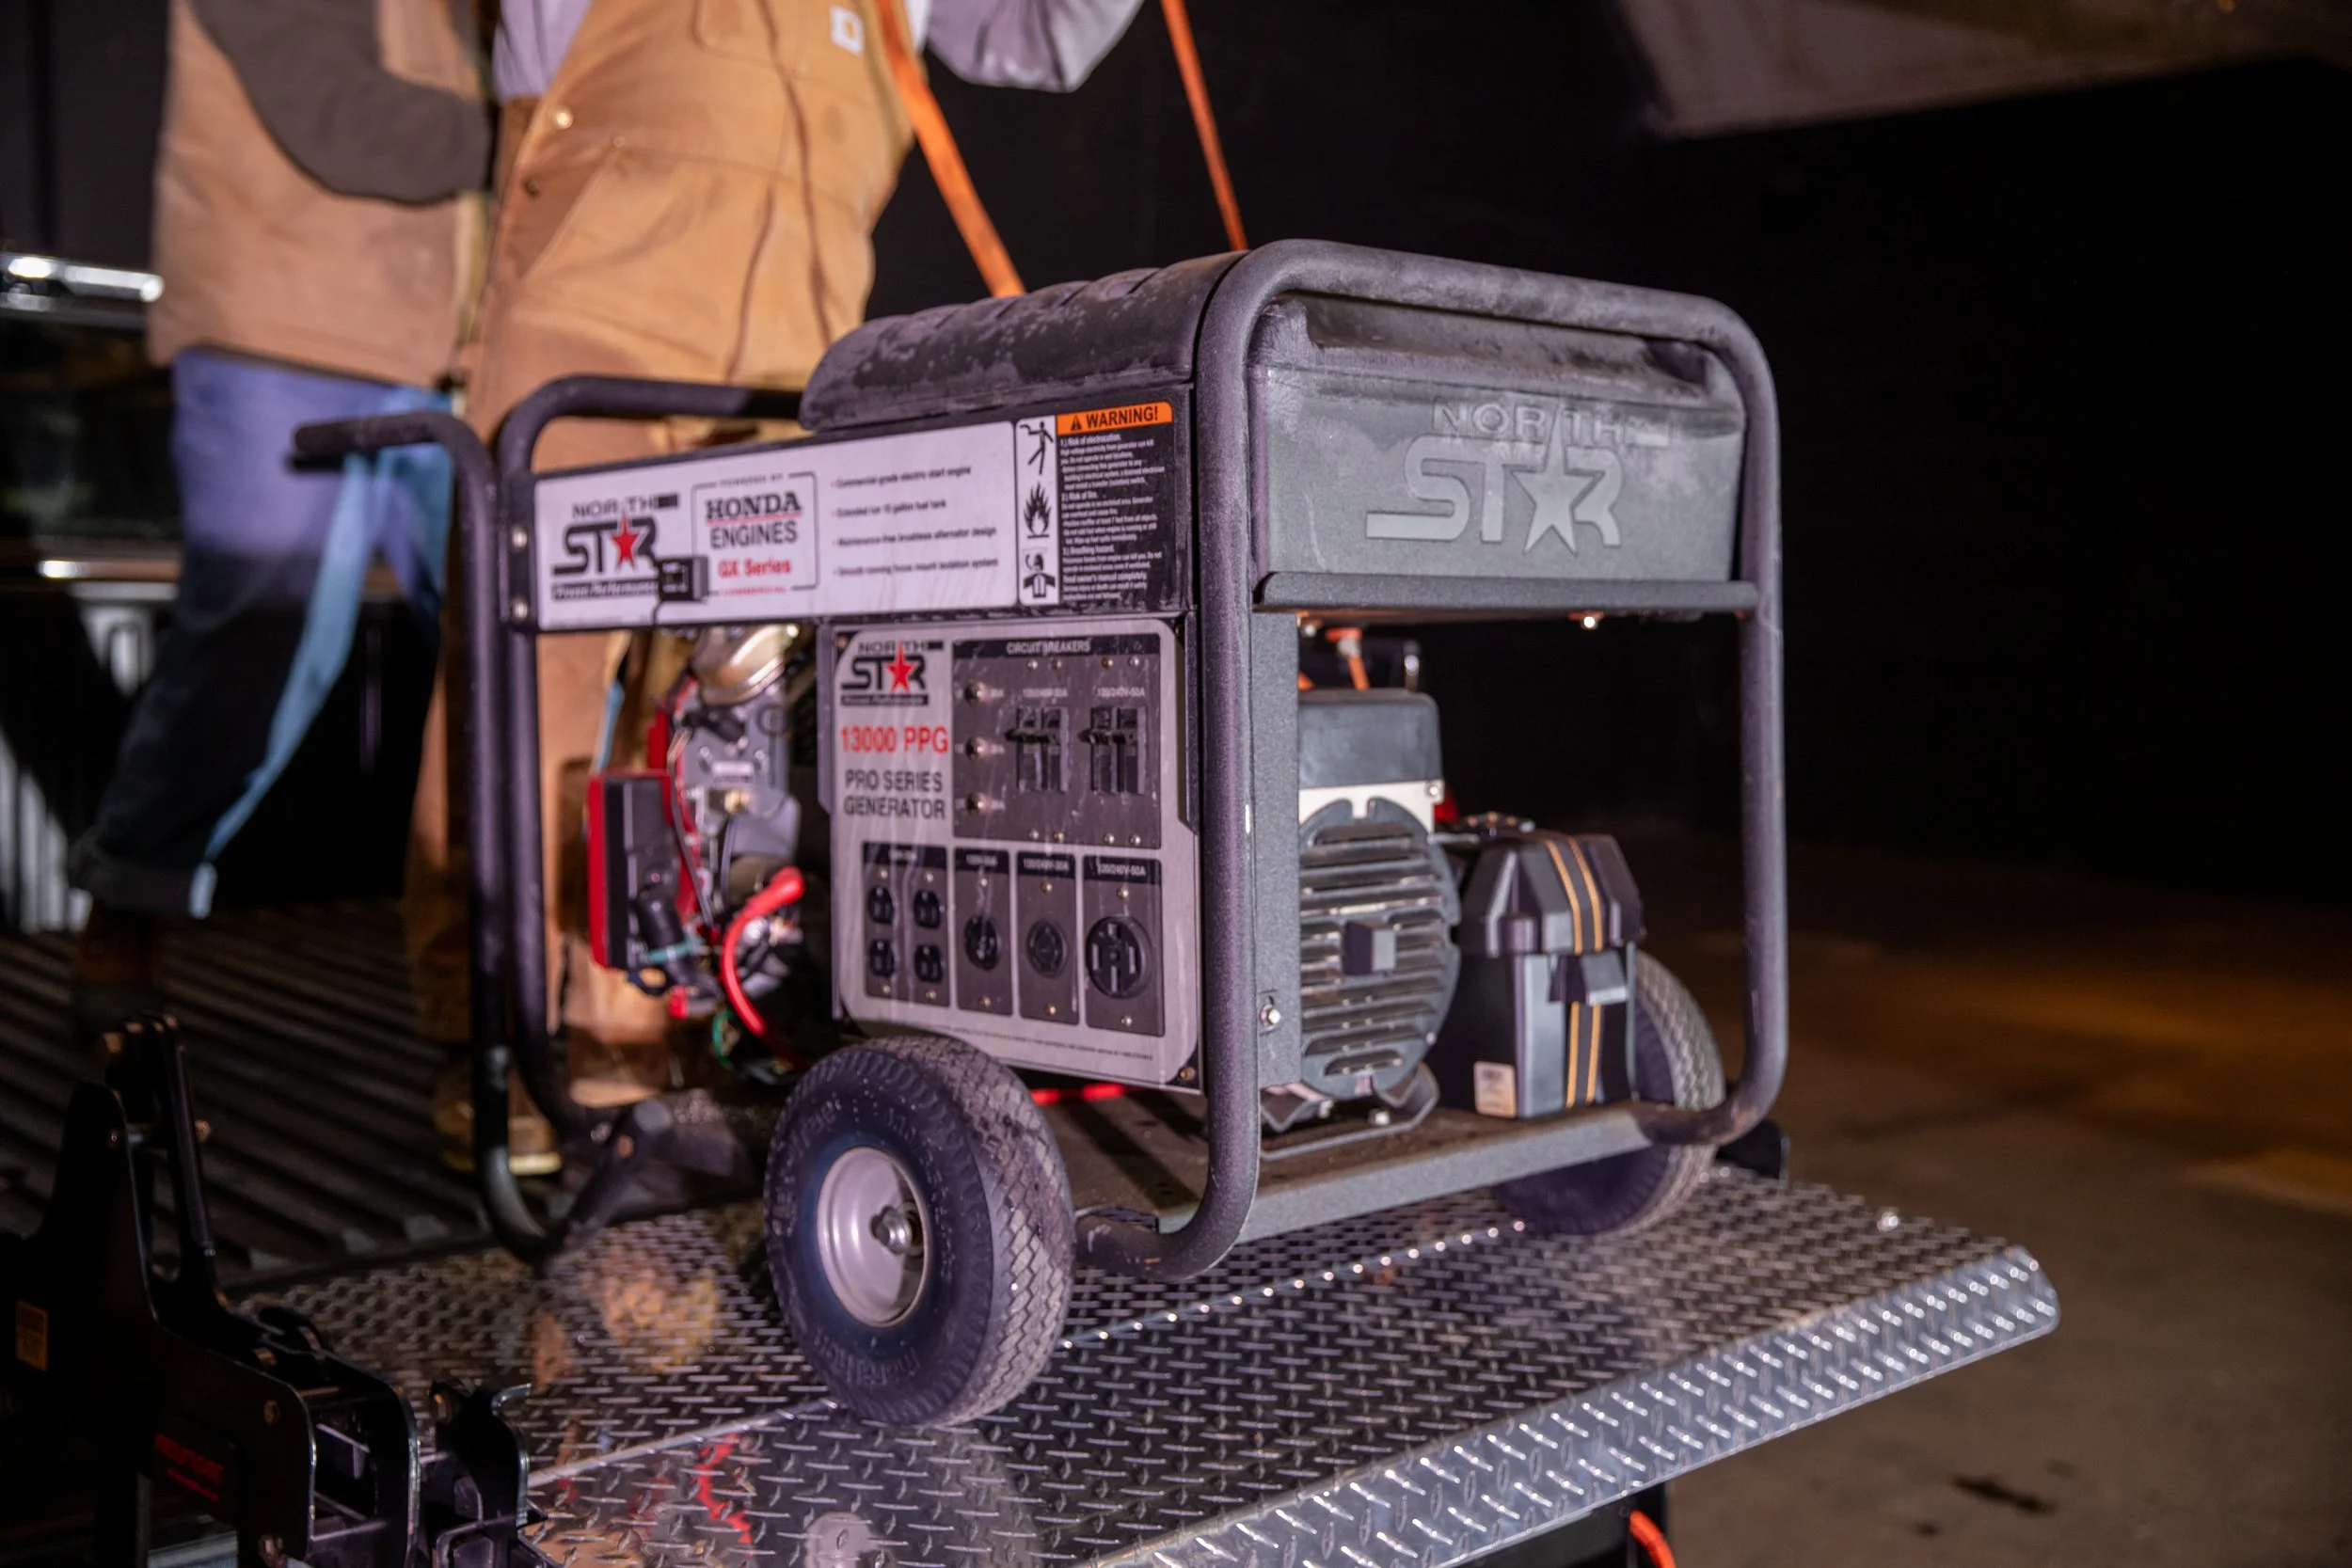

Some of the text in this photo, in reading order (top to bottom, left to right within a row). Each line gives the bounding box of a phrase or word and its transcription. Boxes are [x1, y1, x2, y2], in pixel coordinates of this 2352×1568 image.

[1087, 405, 1158, 429] WARNING!
[1433, 398, 1624, 446] NORTH
[572, 496, 656, 517] NORTH
[706, 491, 802, 519] HONDA
[710, 519, 798, 549] ENGINES
[718, 557, 792, 578] GX Series
[858, 641, 928, 657] NORTH
[1006, 640, 1091, 655] CIRCUIT BREAKERS
[840, 725, 949, 754] 13000 PPG
[845, 768, 944, 793] PRO SERIES
[843, 796, 946, 820] GENERATOR
